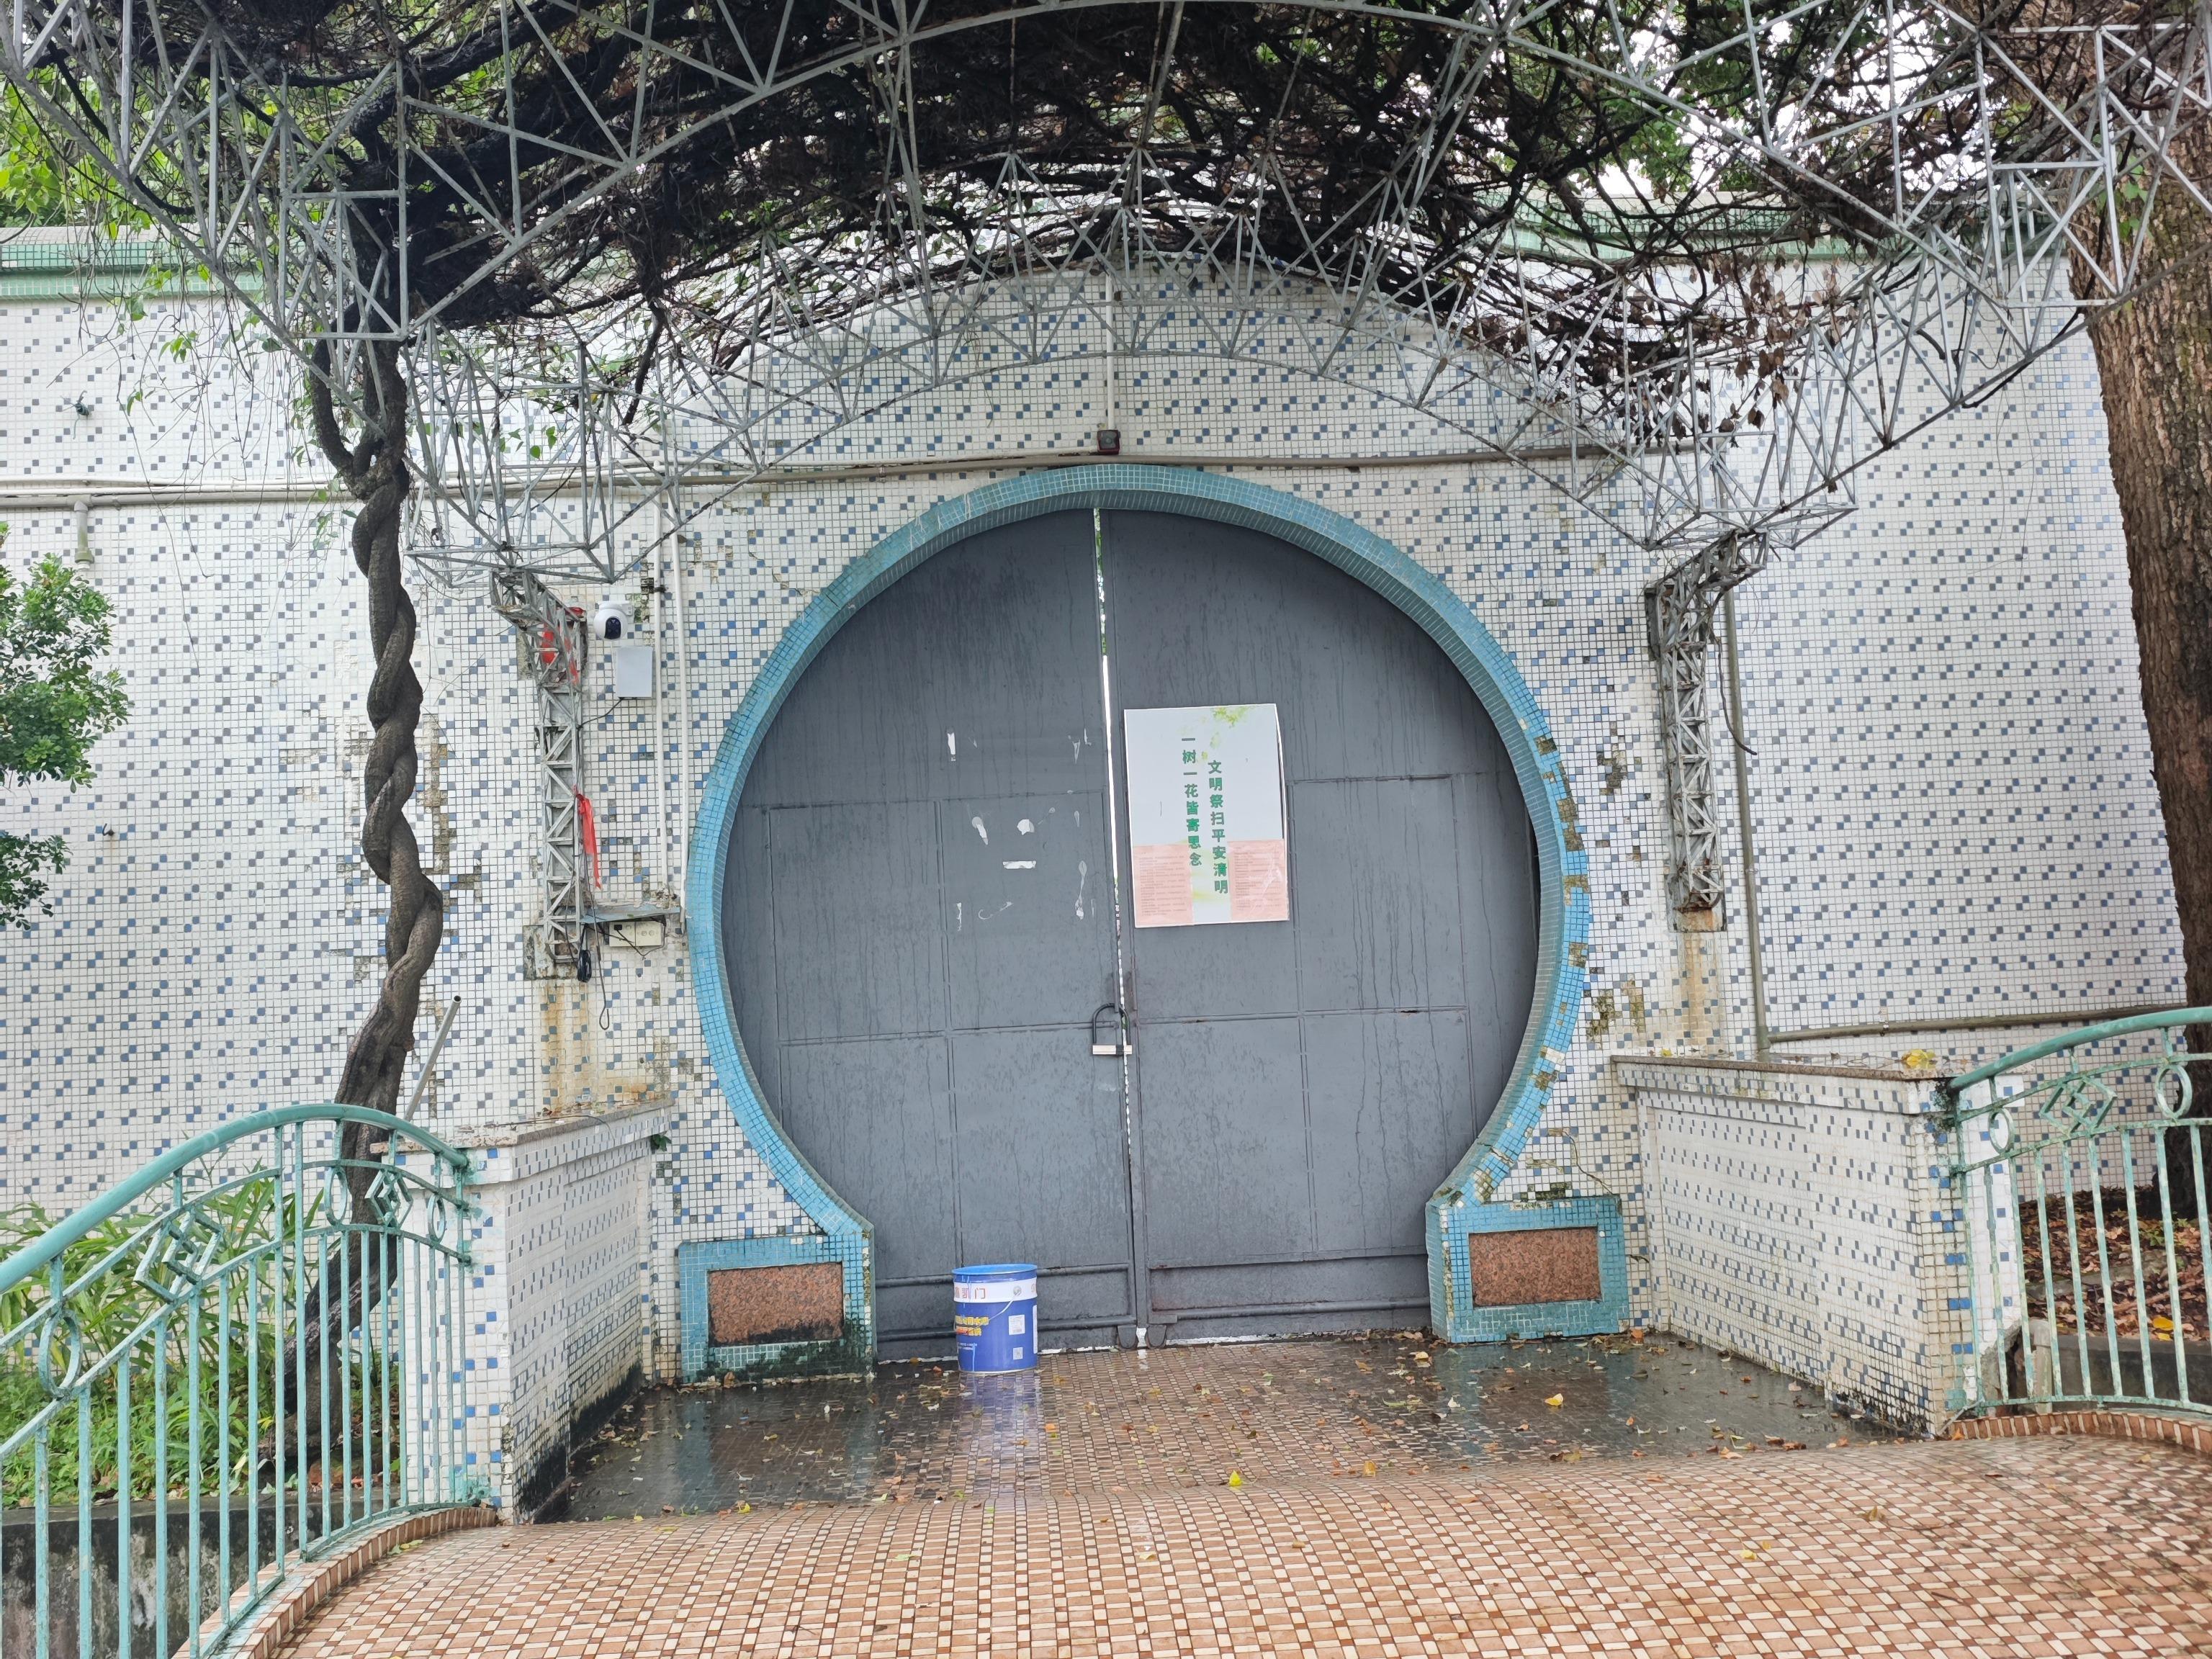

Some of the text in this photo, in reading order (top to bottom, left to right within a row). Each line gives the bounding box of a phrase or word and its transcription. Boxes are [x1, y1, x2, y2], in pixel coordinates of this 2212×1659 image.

[1182, 737, 1202, 866] 一树一花皆寄思念
[1208, 760, 1228, 894] 文明祭扫平安清明
